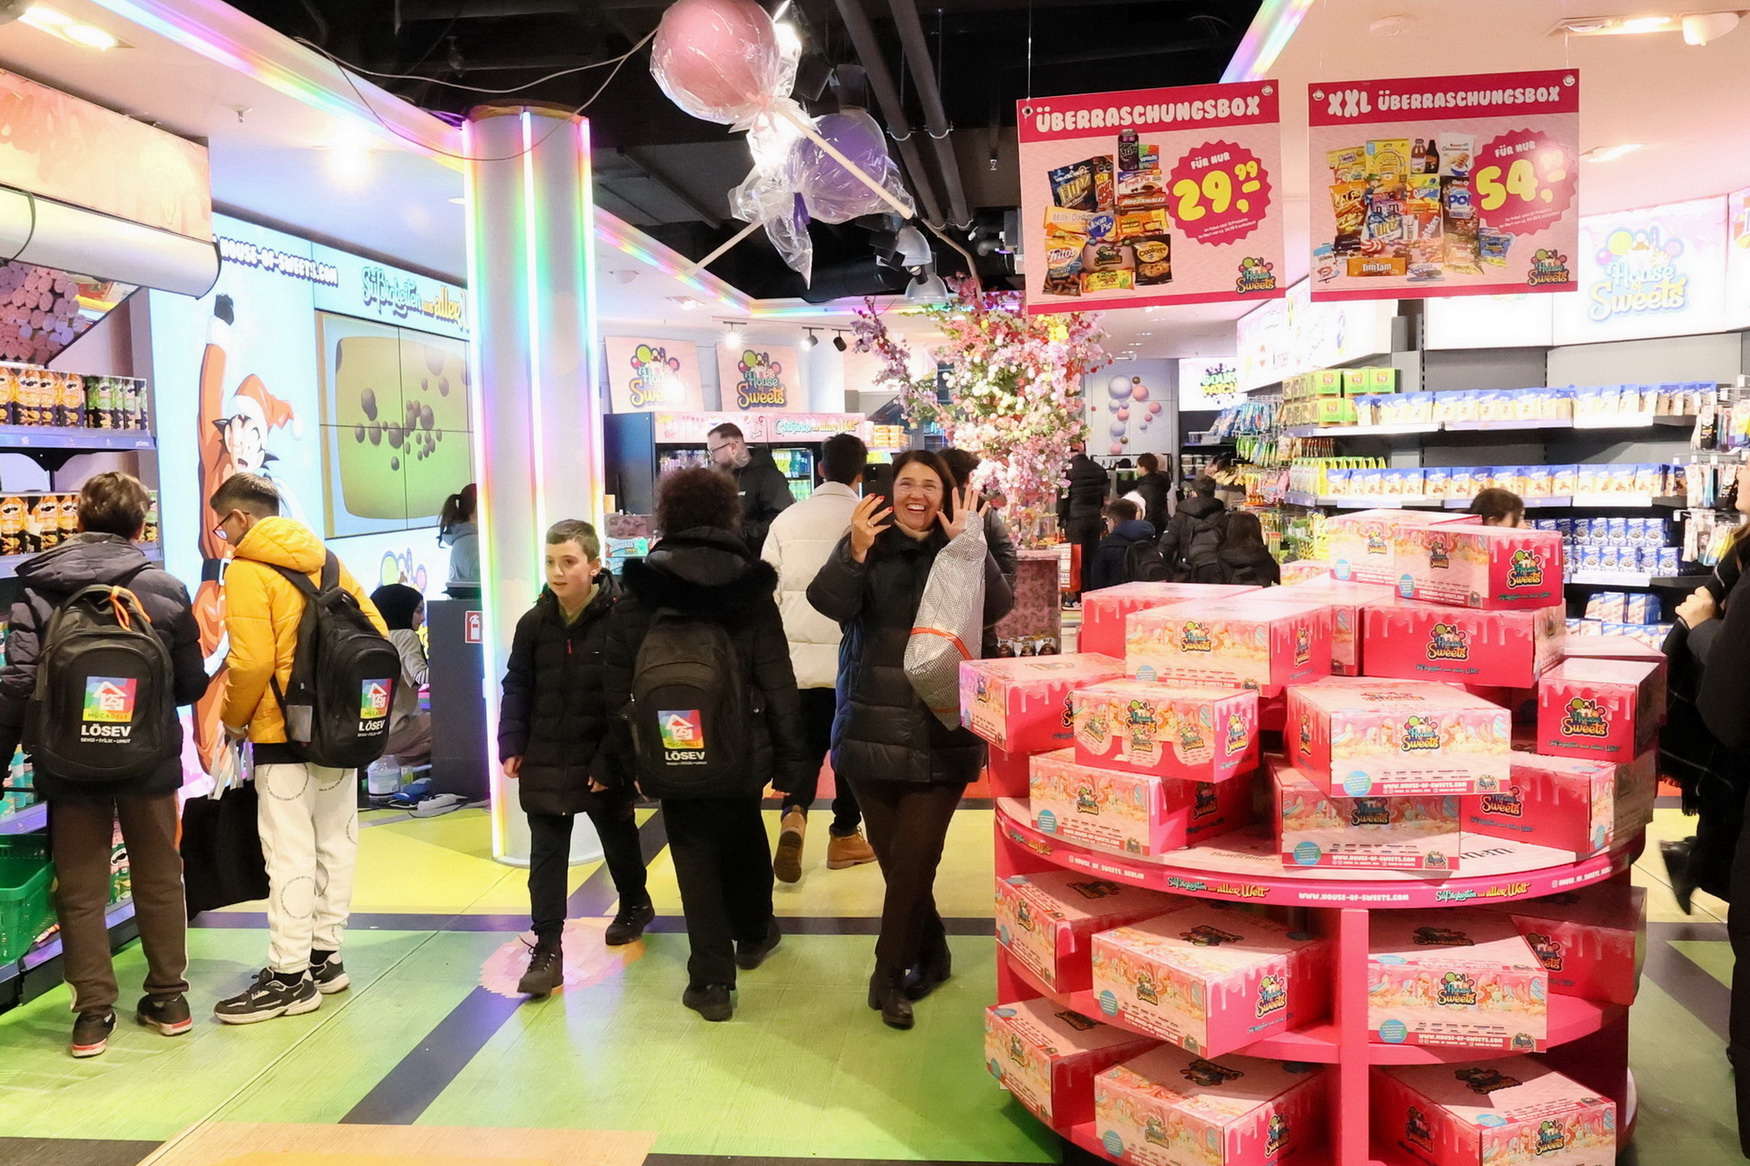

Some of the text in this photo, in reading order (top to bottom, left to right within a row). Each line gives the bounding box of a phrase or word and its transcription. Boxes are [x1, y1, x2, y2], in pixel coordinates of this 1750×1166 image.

[1327, 84, 1560, 118] XXL ÜBERRASCHUNGSBOX
[1036, 95, 1261, 132] ÜBERRASCHUNGSBOX
[1494, 140, 1536, 158] FÜR NUR
[1191, 152, 1231, 170] FÜR NUR
[213, 233, 338, 288] HOUSE-OF-SWEETS.COM
[1236, 276, 1276, 293] Sweets
[1528, 267, 1569, 286] Sweets
[1606, 261, 1676, 290] House
[1589, 276, 1688, 322] Sweets
[744, 370, 780, 389] House
[736, 382, 787, 410] Sweets
[1508, 570, 1541, 587] Sweets
[1427, 643, 1468, 660] Sweets
[81, 724, 132, 737] LÖSEV
[359, 720, 386, 732] LÖSEV
[1562, 718, 1608, 737] Sweets
[1401, 735, 1440, 752] Sweets
[665, 751, 706, 761] LÖSEV
[1482, 796, 1523, 816] Sweets
[1351, 811, 1390, 827] Sweets
[1240, 884, 1270, 898] Welt
[1298, 891, 1409, 902] WWW.HOUSE-OF-SWEETS.COM
[1255, 993, 1285, 1018] Sweets
[1437, 989, 1476, 1005] Sweets
